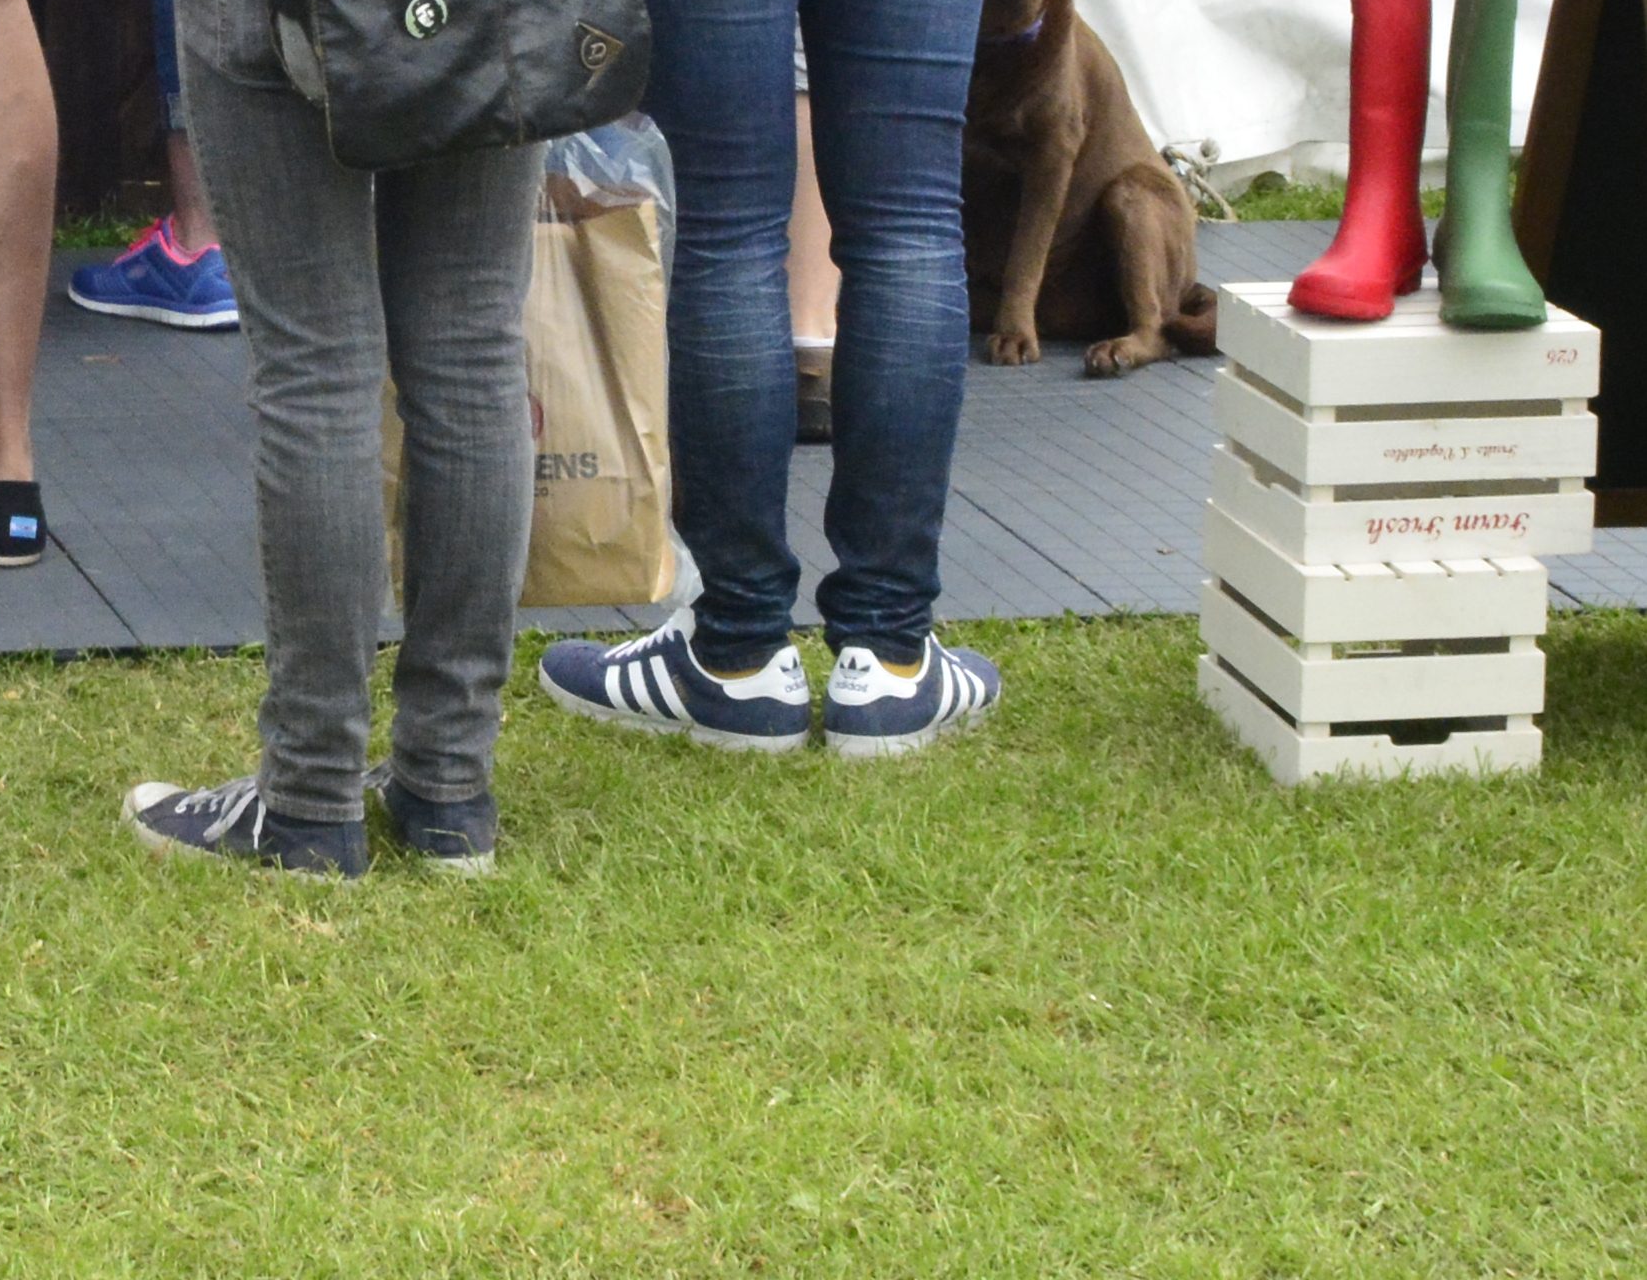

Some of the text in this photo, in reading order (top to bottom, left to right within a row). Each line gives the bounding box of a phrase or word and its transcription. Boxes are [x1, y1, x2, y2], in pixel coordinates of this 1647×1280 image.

[1382, 443, 1455, 463] Vegetables
[1477, 445, 1518, 459] Fruits
[534, 451, 599, 480] ENS
[1366, 512, 1530, 545] Farm Fresh
